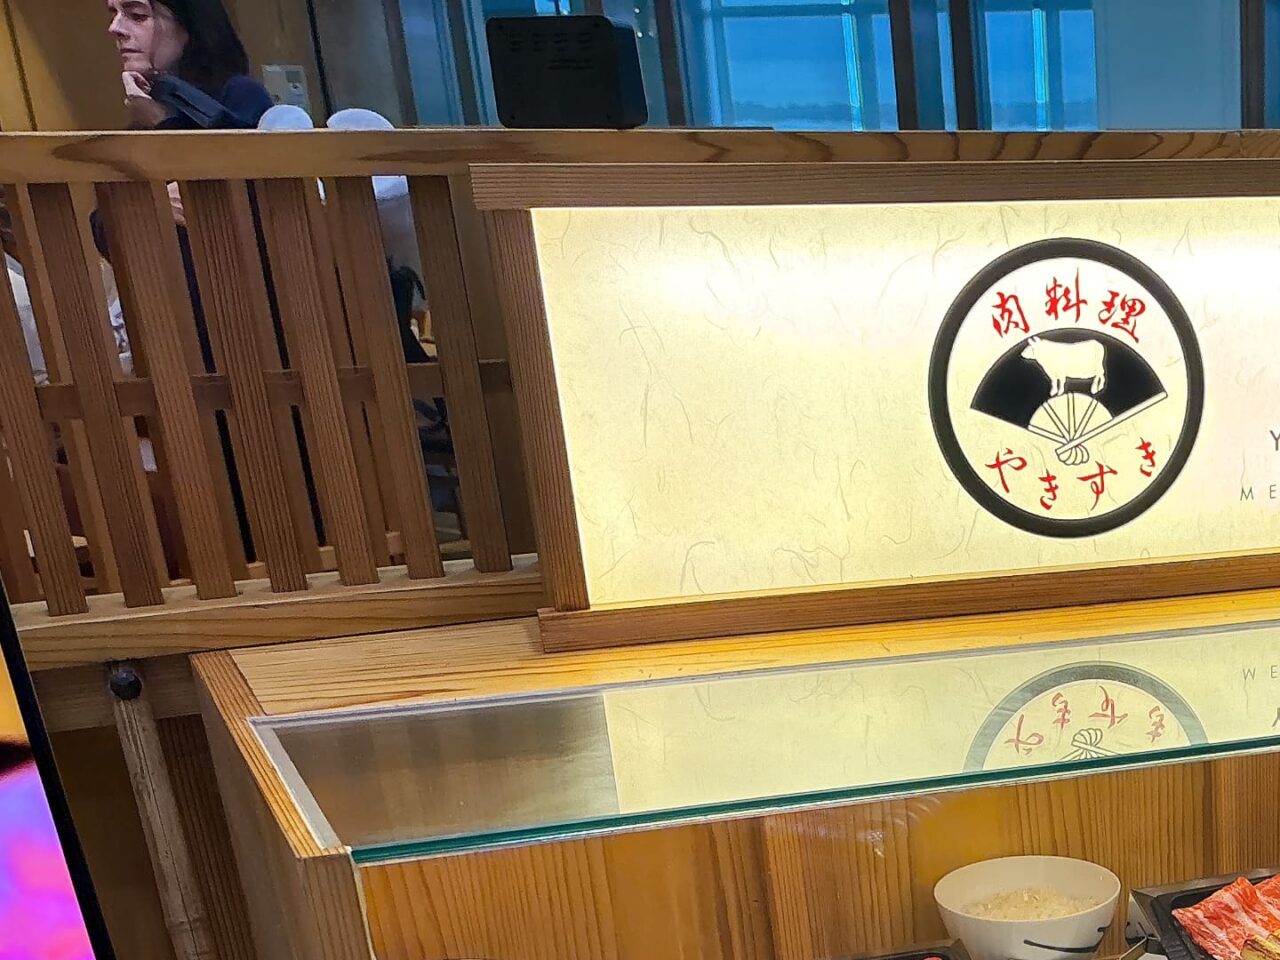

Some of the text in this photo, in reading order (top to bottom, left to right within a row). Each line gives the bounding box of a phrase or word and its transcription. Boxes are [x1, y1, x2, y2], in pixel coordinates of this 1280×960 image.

[991, 268, 1146, 343] 肉料理
[985, 437, 1158, 511] やきすき
